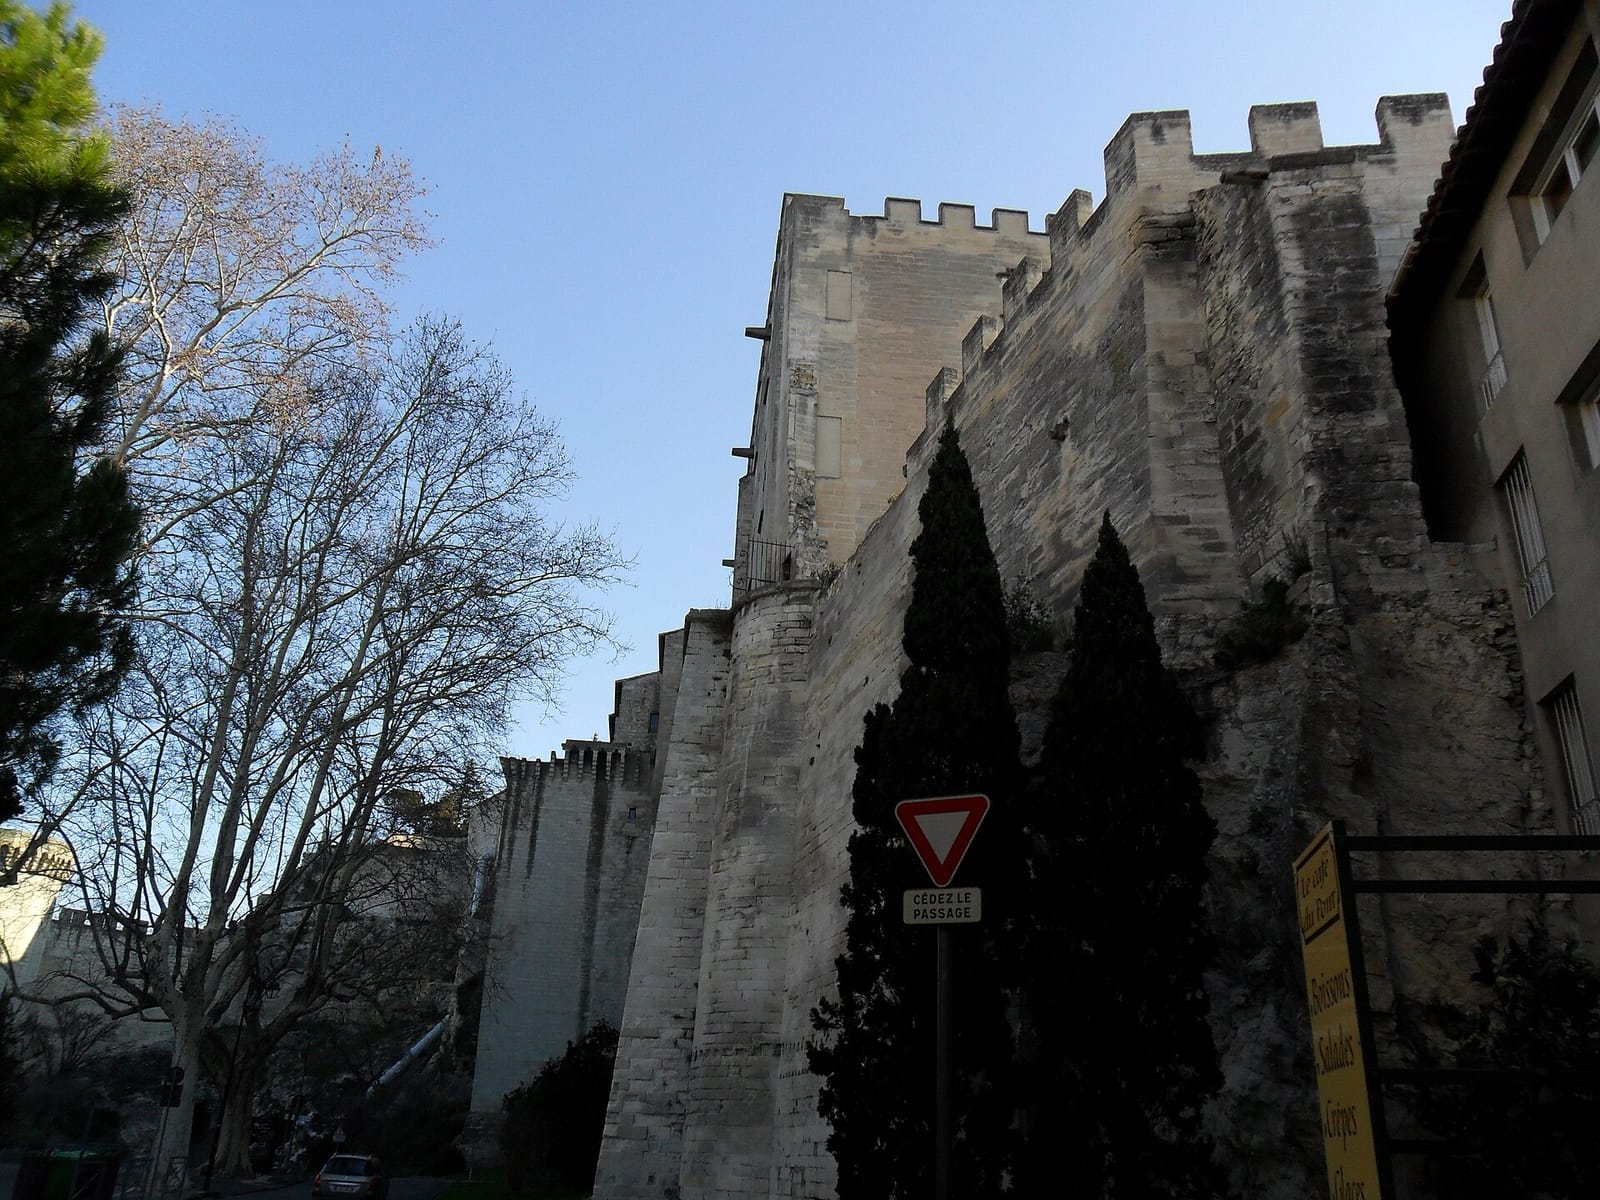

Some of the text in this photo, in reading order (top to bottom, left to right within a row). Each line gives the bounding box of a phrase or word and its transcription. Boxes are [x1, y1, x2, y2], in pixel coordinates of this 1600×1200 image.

[1301, 849, 1329, 899] Le café
[913, 891, 972, 905] CÉDEZ LE
[913, 907, 971, 920] PASSAGE
[1303, 905, 1316, 932] du
[1311, 967, 1351, 1017] Boissons
[1317, 1023, 1356, 1076] Salades
